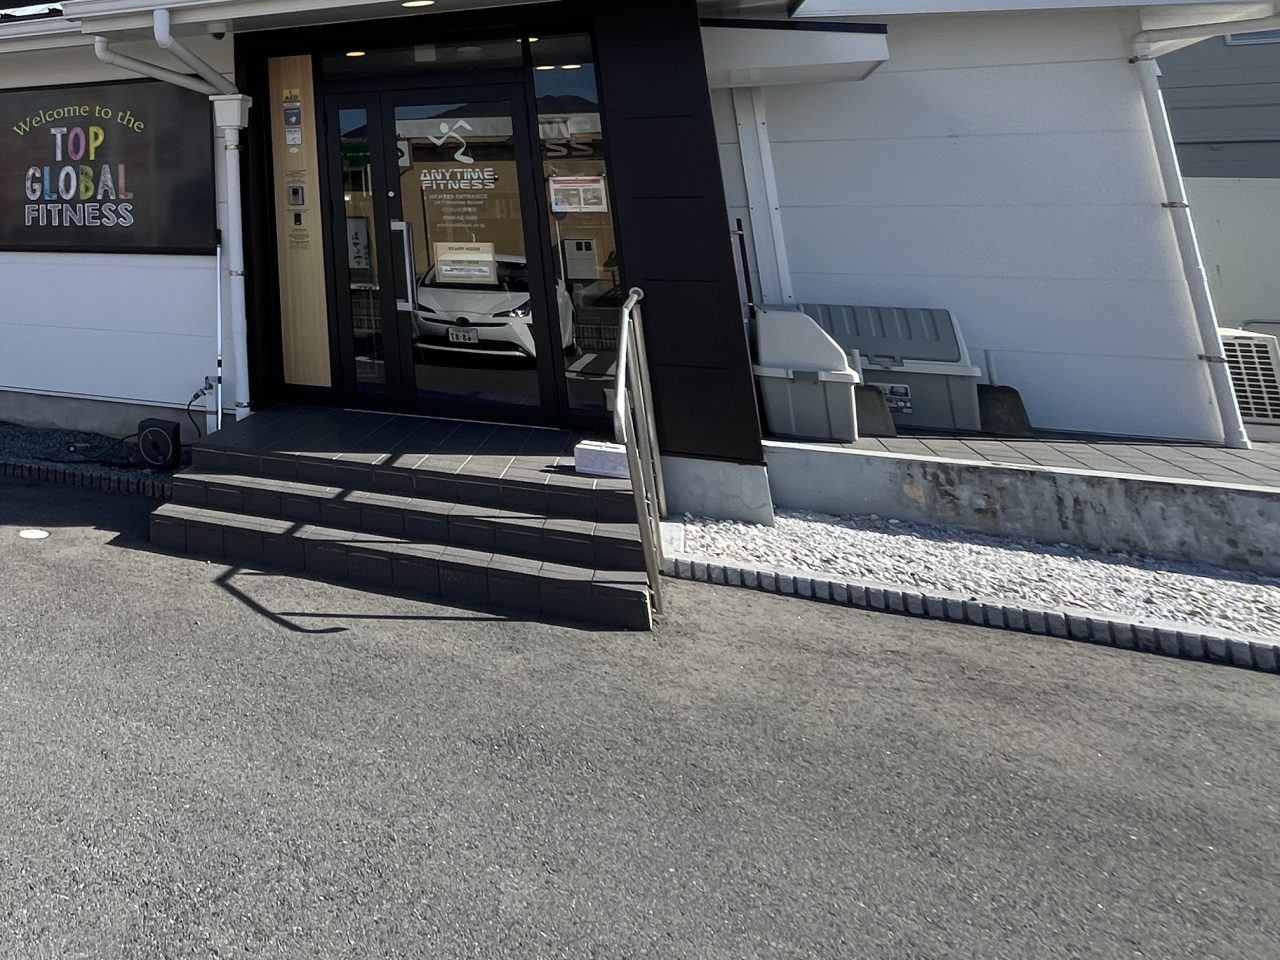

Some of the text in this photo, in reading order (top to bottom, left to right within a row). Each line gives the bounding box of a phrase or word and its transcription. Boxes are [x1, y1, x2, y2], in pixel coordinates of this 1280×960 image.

[12, 104, 145, 137] Welcome to the
[50, 125, 105, 162] TOP
[25, 163, 133, 201] GLOBAL
[420, 168, 495, 181] ANYTIME
[422, 179, 495, 190] FITNESS
[24, 202, 134, 227] FITNESS
